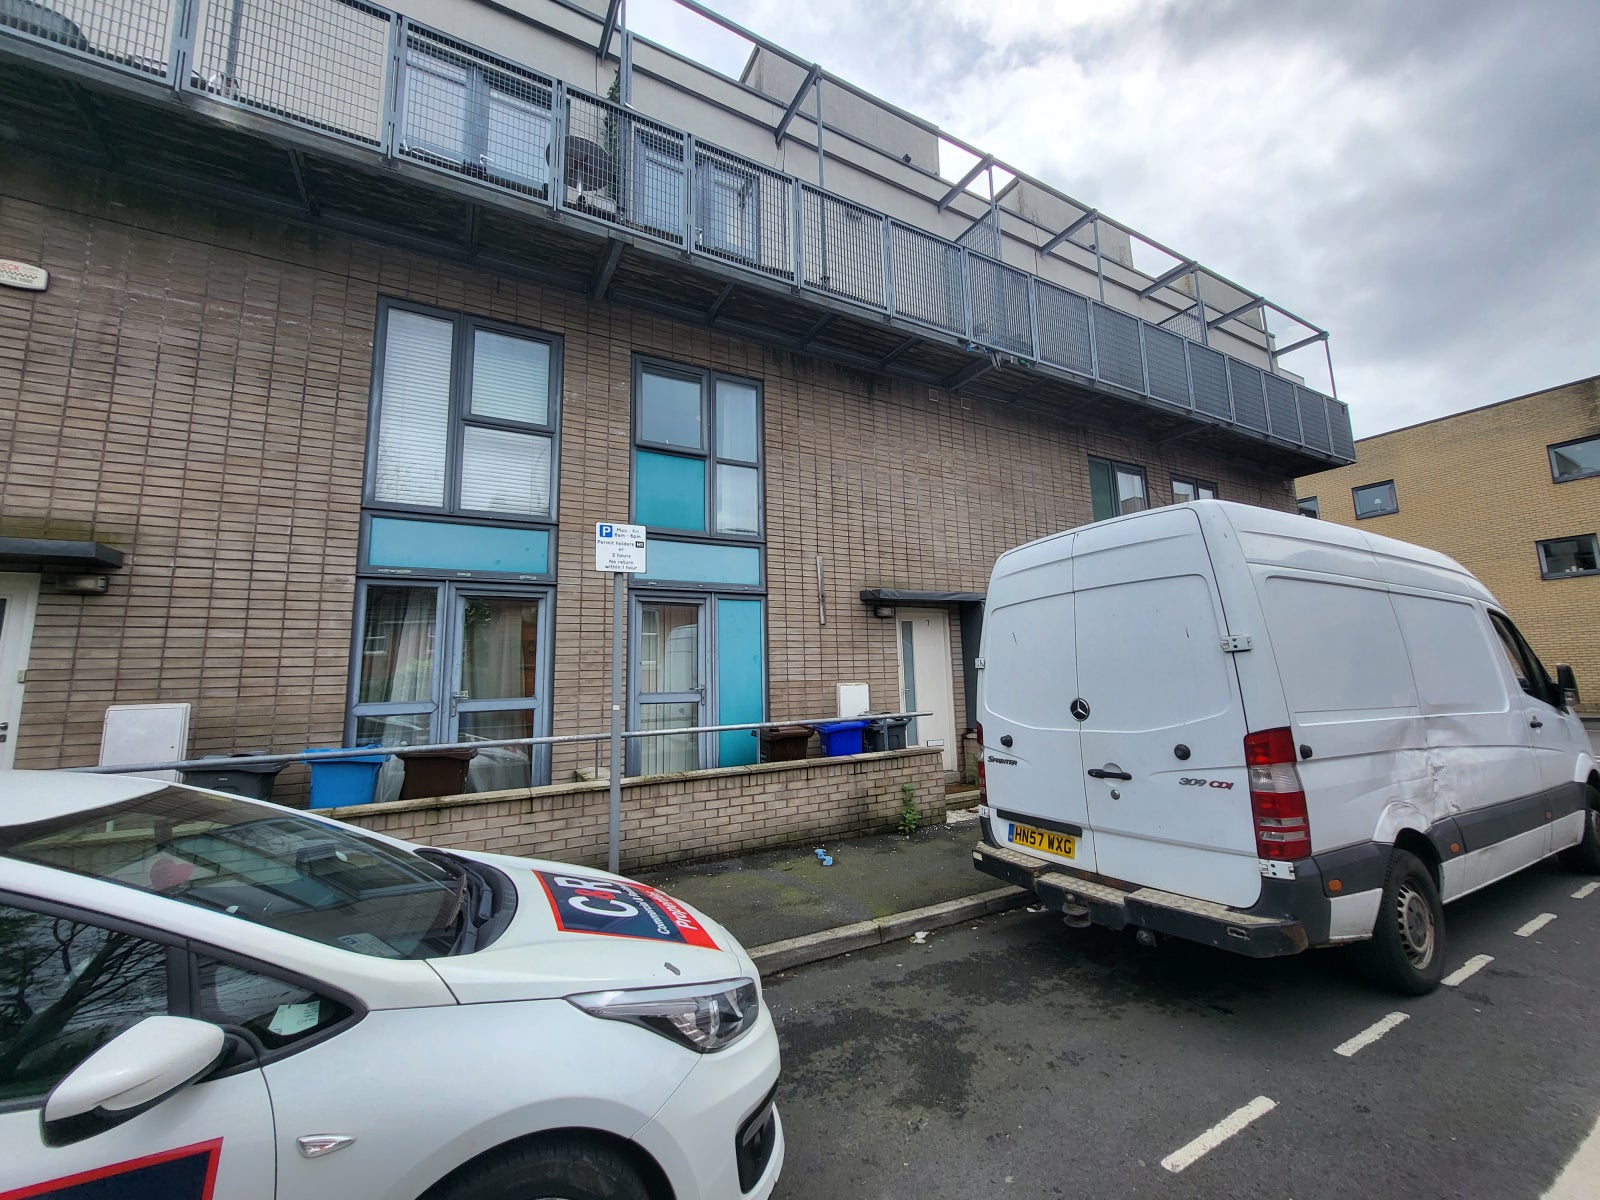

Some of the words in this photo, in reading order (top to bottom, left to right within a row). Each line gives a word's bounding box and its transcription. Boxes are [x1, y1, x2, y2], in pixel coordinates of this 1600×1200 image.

[602, 526, 611, 537] P
[1179, 777, 1207, 787] 309
[1209, 780, 1234, 790] CDI
[1015, 826, 1044, 847] HN57
[1047, 834, 1072, 855] WXG
[636, 901, 670, 935] Commercial
